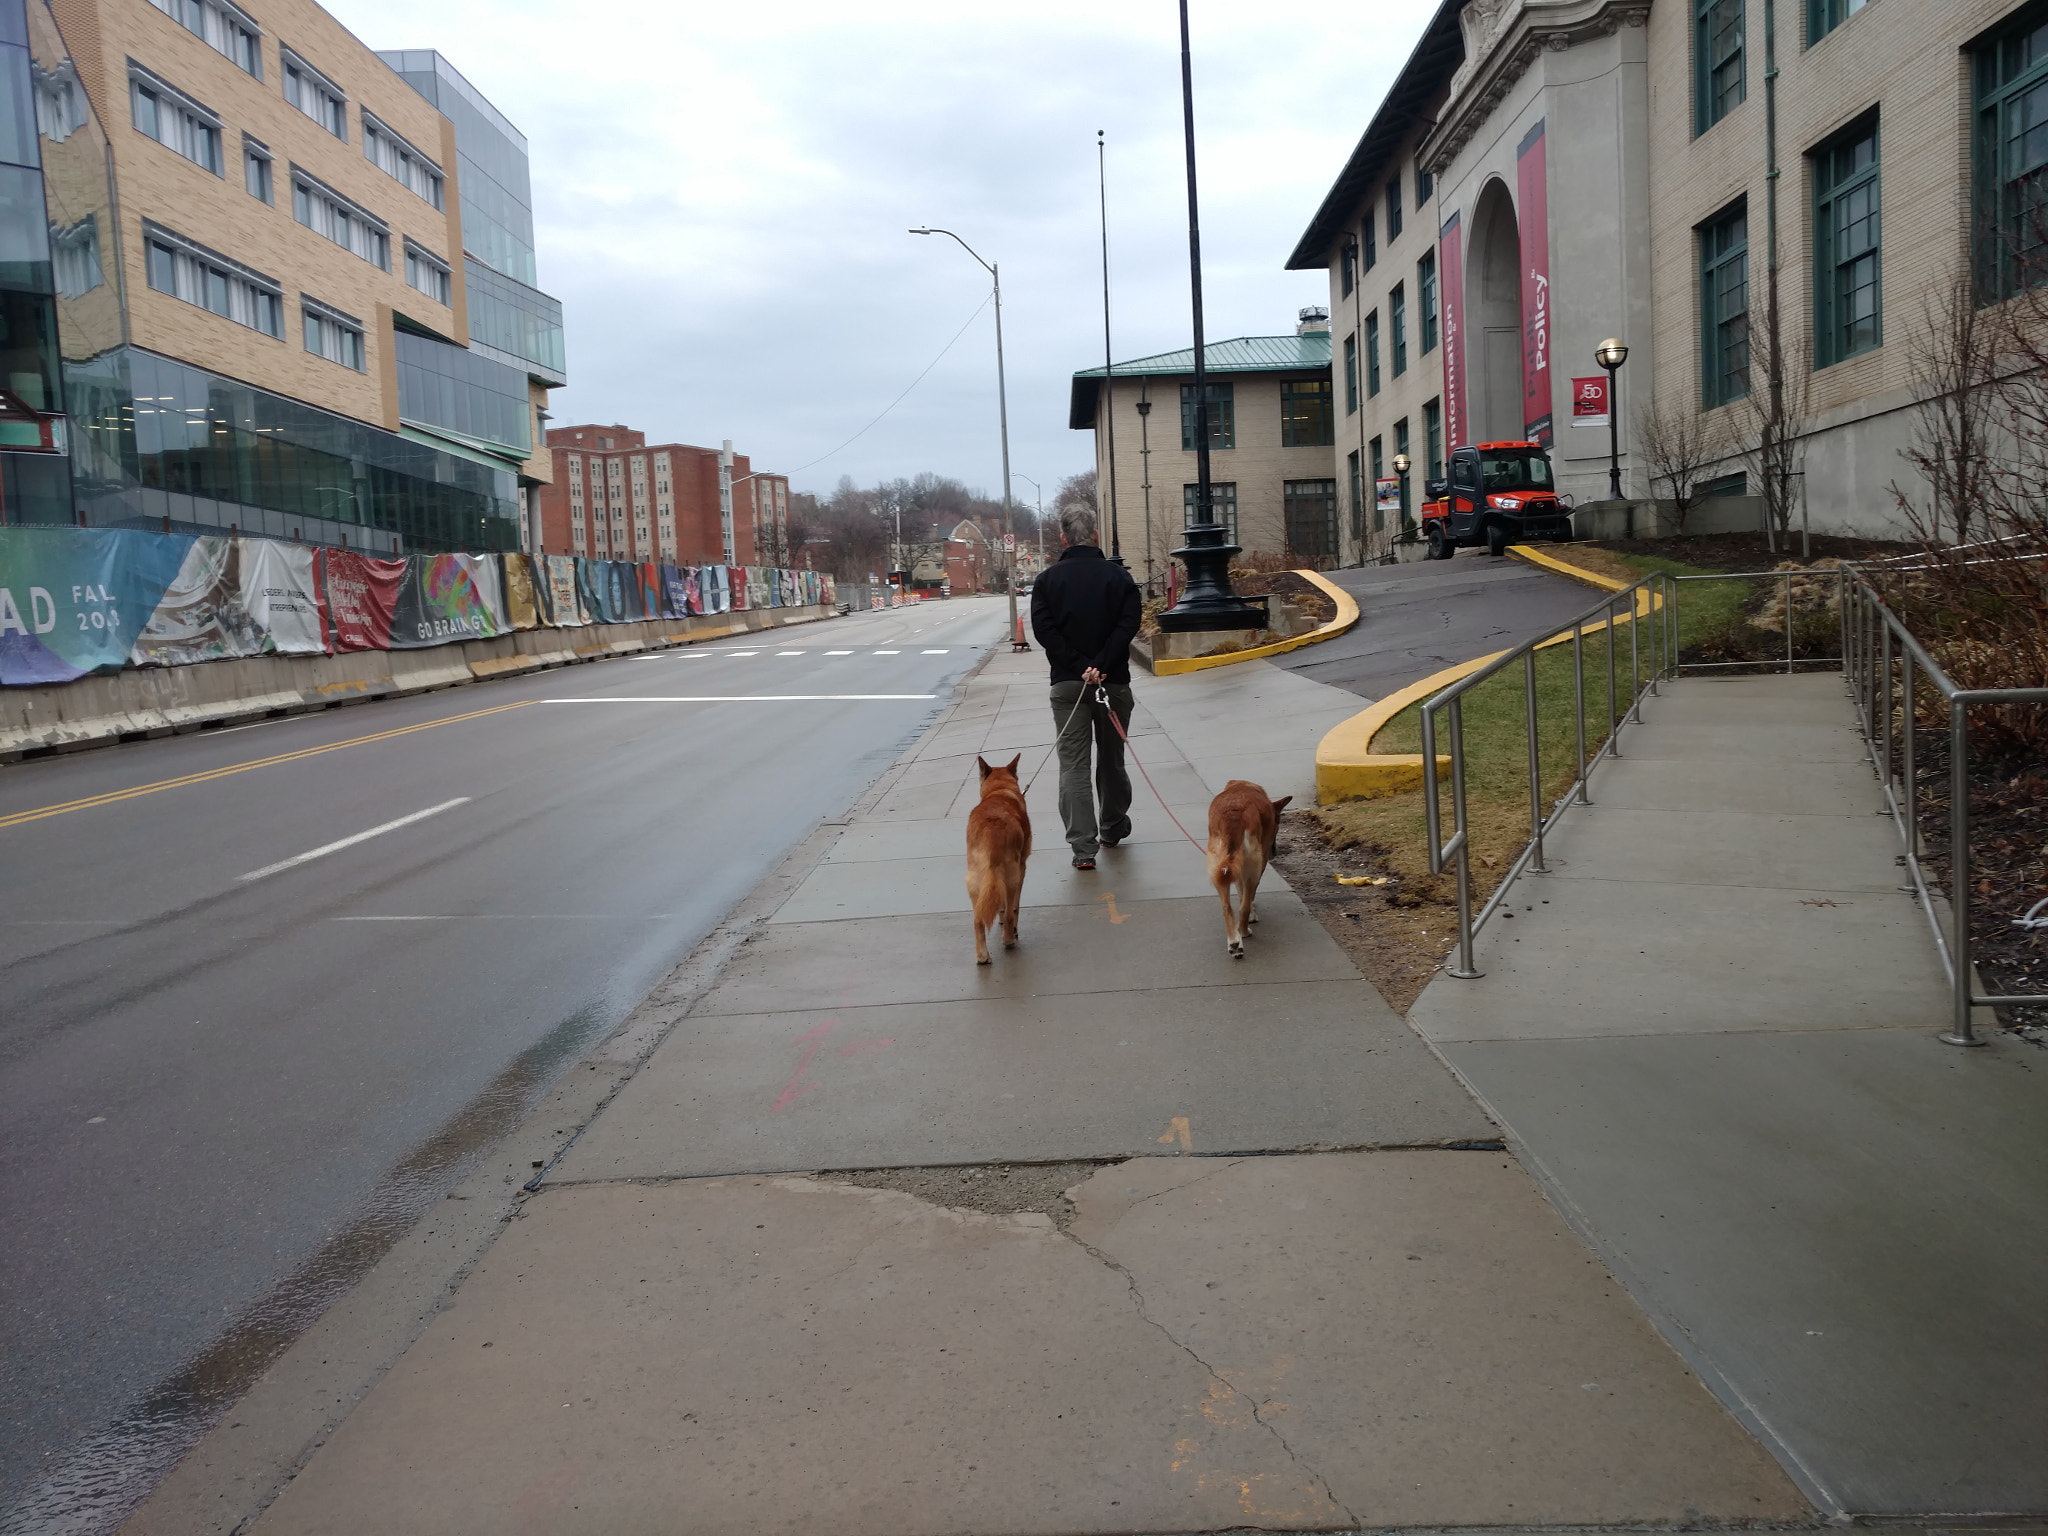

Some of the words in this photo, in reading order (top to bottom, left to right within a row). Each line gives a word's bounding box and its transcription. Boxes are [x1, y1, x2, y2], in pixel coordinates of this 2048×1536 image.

[1534, 274, 1548, 371] Policy
[1445, 303, 1457, 447] Information
[418, 622, 432, 639] GO
